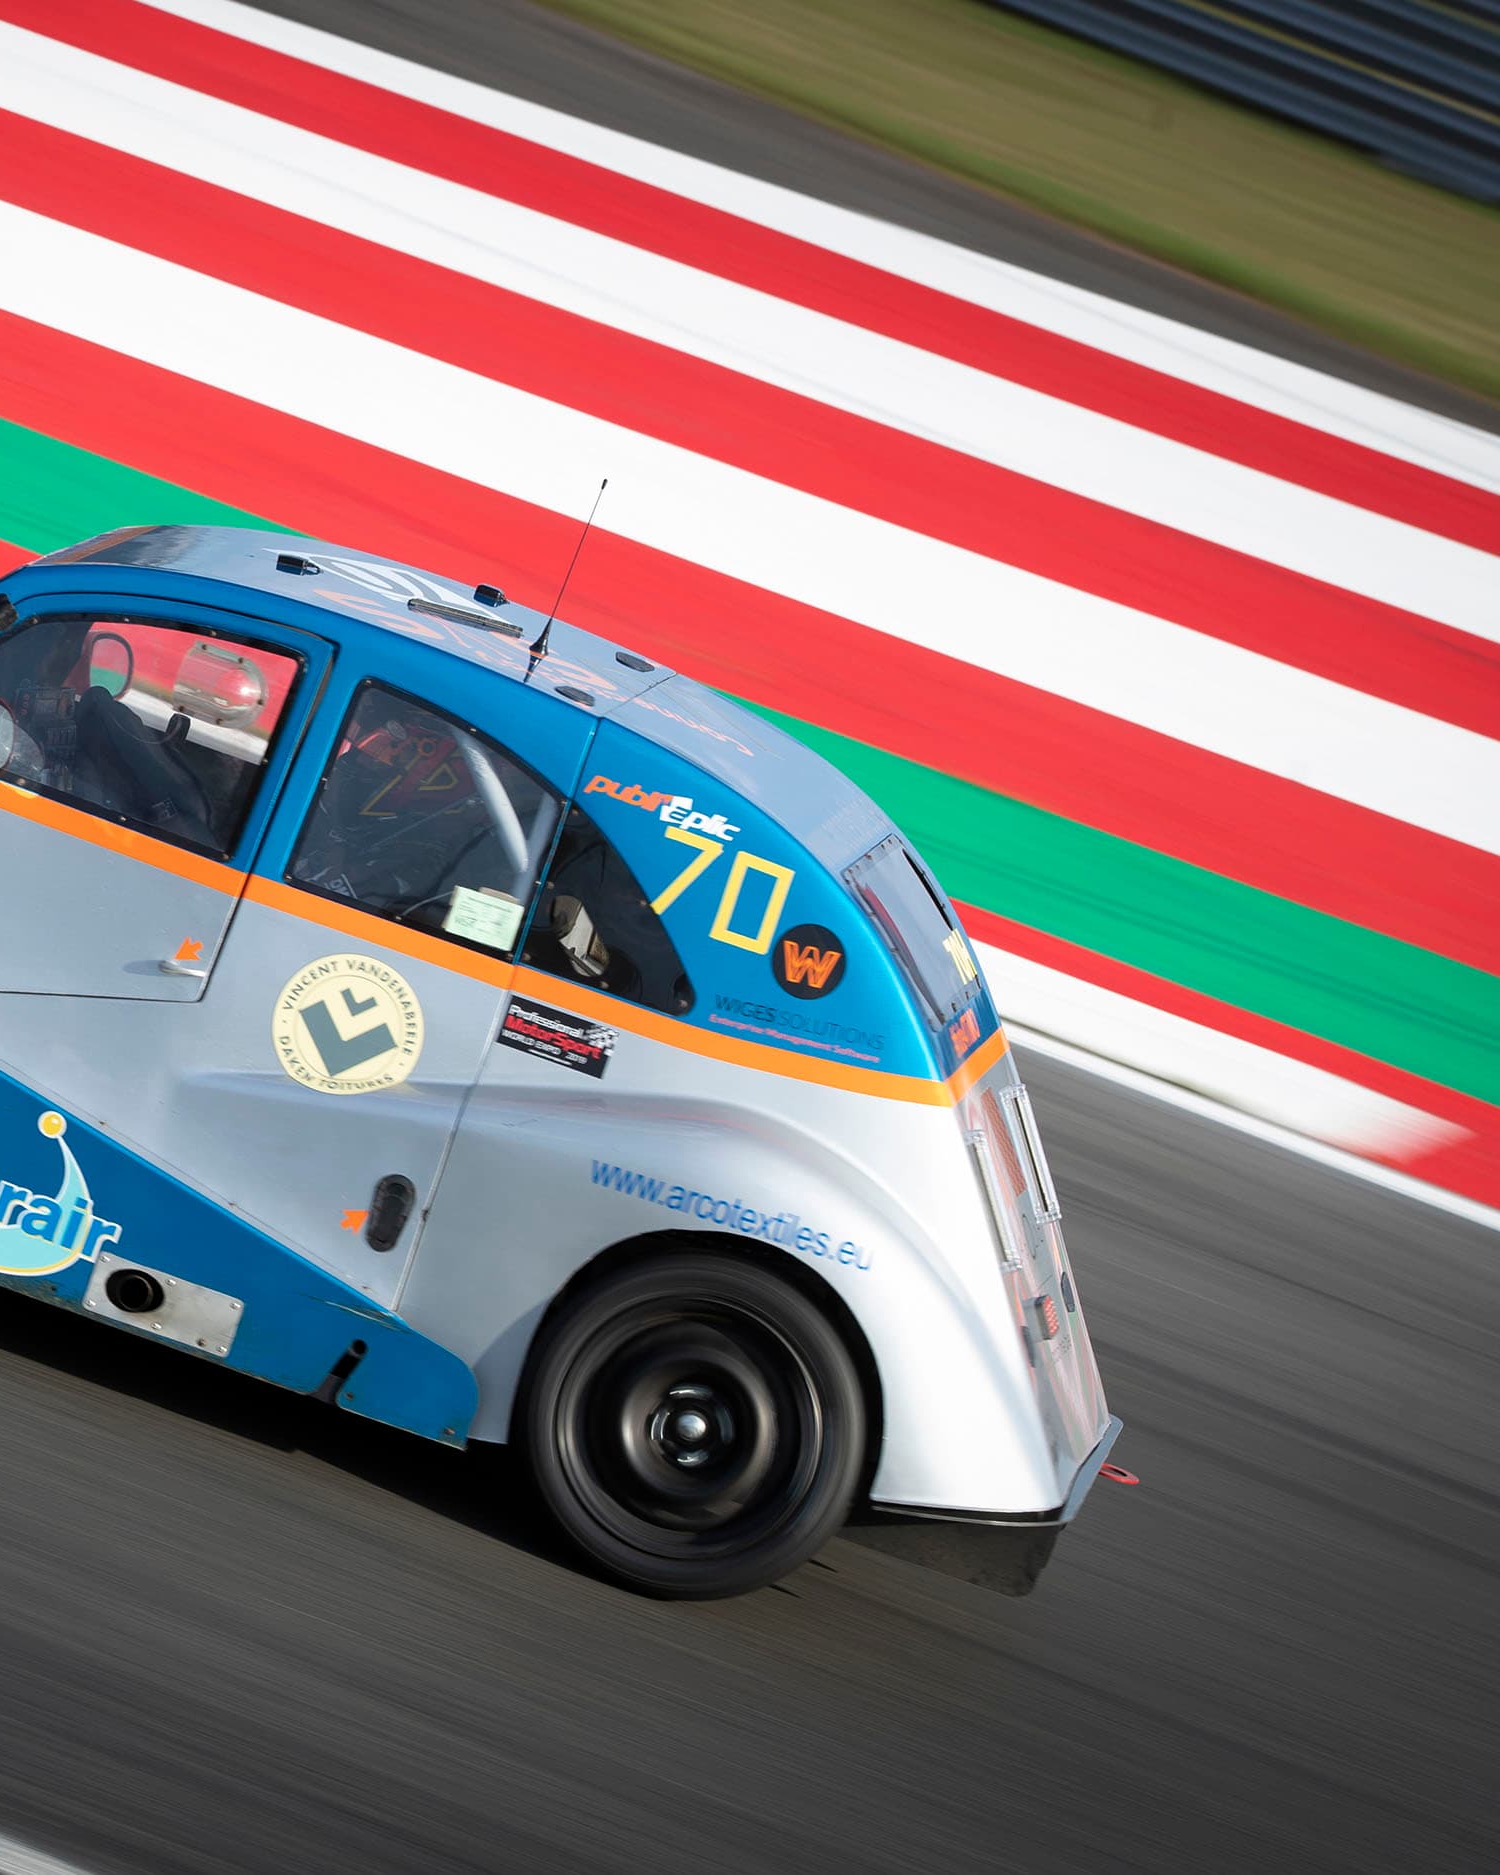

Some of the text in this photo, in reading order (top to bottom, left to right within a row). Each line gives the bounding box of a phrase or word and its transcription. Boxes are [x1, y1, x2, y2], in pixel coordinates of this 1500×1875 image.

[650, 826, 796, 955] 70
[283, 960, 341, 1011] VINCENT
[590, 1158, 874, 1271] www.arcotextiles.eu
